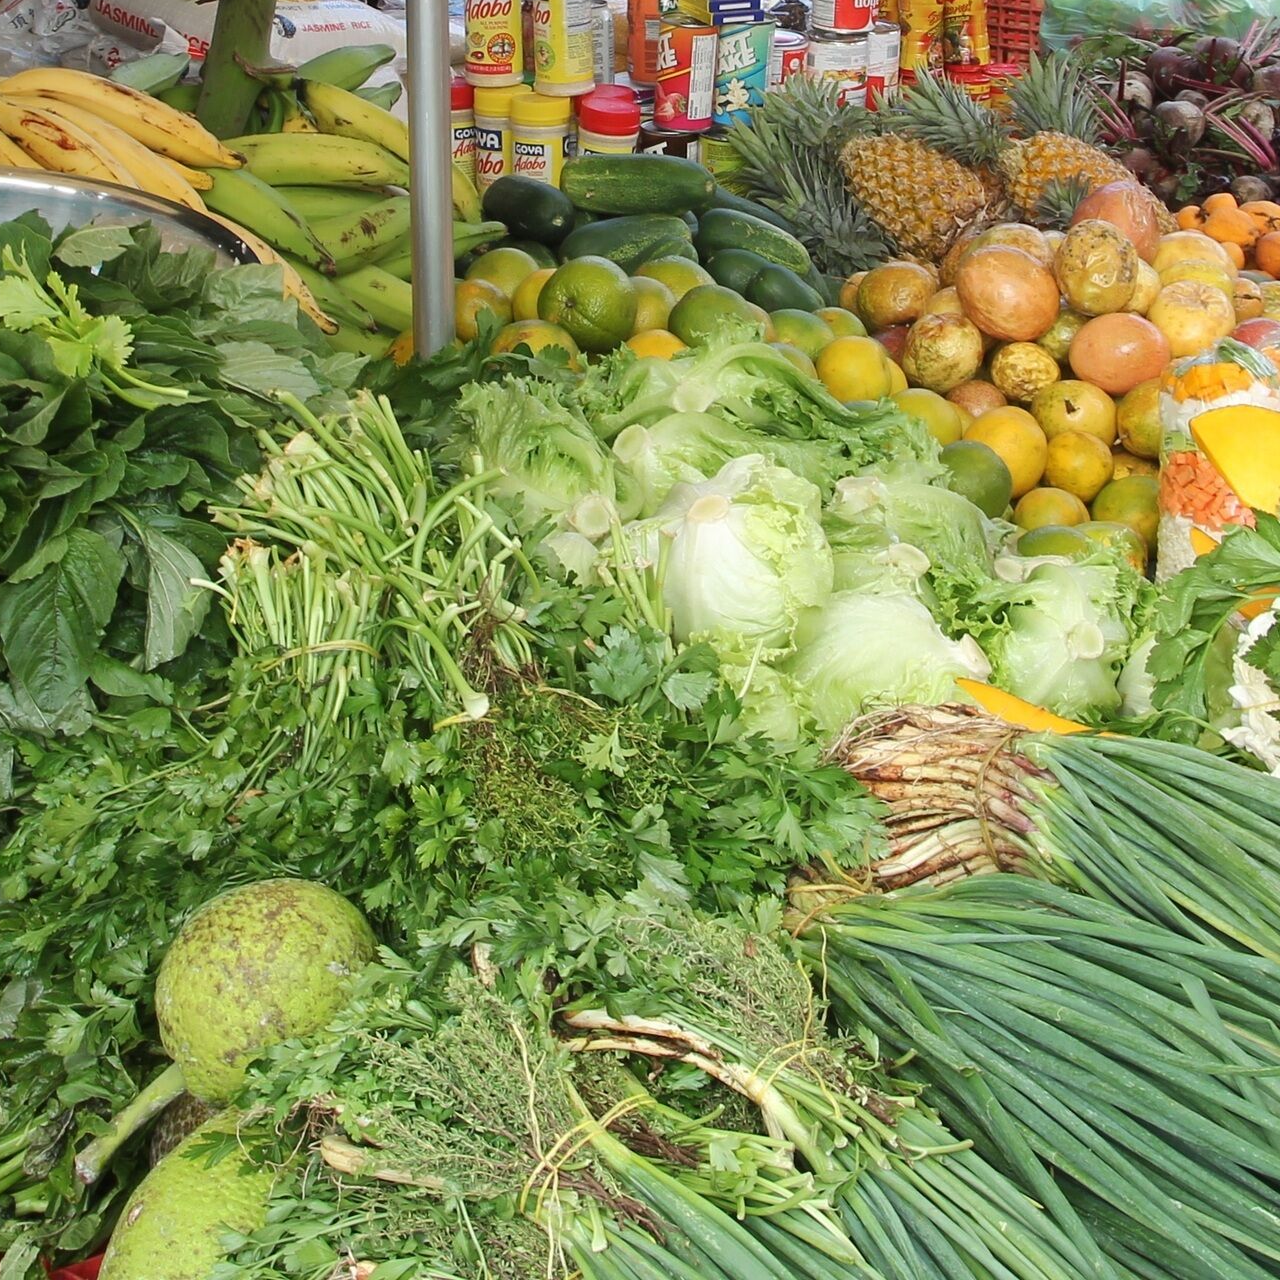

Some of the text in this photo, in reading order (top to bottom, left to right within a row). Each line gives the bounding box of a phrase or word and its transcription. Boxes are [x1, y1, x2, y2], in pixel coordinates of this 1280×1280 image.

[302, 20, 373, 33] JASMINE RICE
[515, 143, 544, 156] GOYA
[514, 155, 547, 174] Adobo
